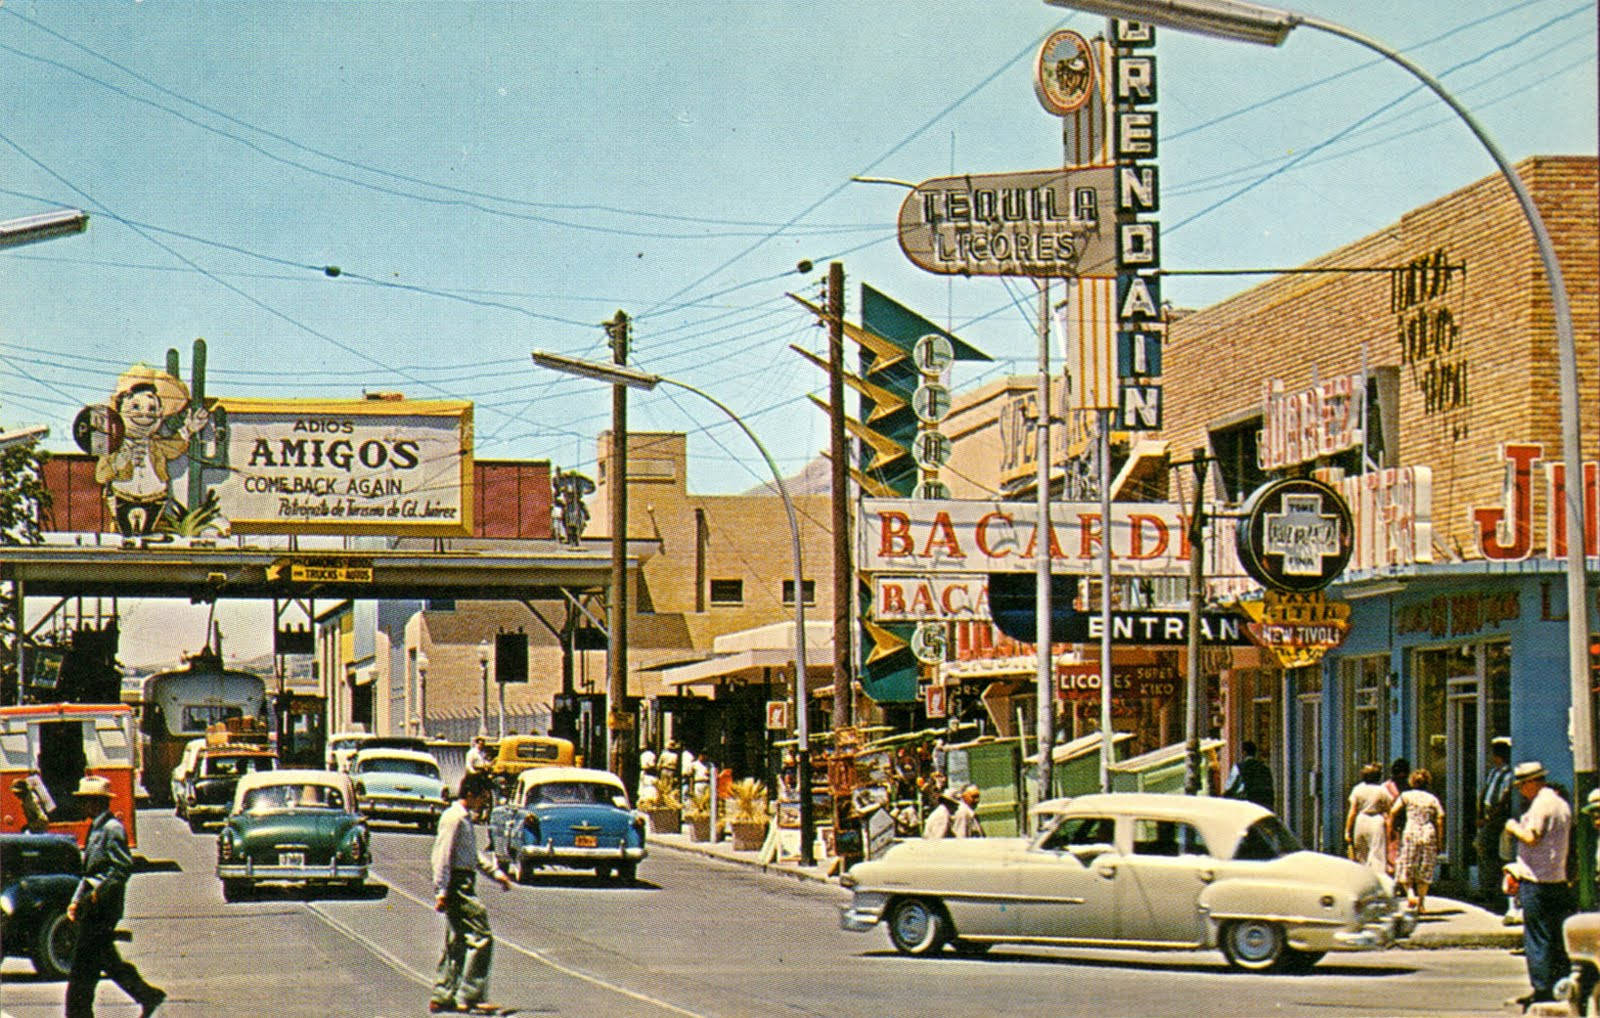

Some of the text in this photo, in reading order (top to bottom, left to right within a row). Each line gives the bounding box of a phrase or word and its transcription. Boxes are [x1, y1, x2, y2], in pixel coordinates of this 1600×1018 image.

[923, 186, 1098, 225] TEQUILA
[937, 231, 1076, 262] LICORES
[293, 419, 354, 433] ADIOS
[248, 436, 420, 472] AMIGO'S
[244, 477, 402, 495] COME BACK AGAIN
[331, 500, 345, 516] de
[386, 499, 400, 516] de
[877, 511, 1194, 560] BACARDI
[1088, 616, 1240, 640] ENTRAN
[1263, 626, 1340, 645] NEW TIVOLI
[1060, 673, 1132, 690] LICOES
